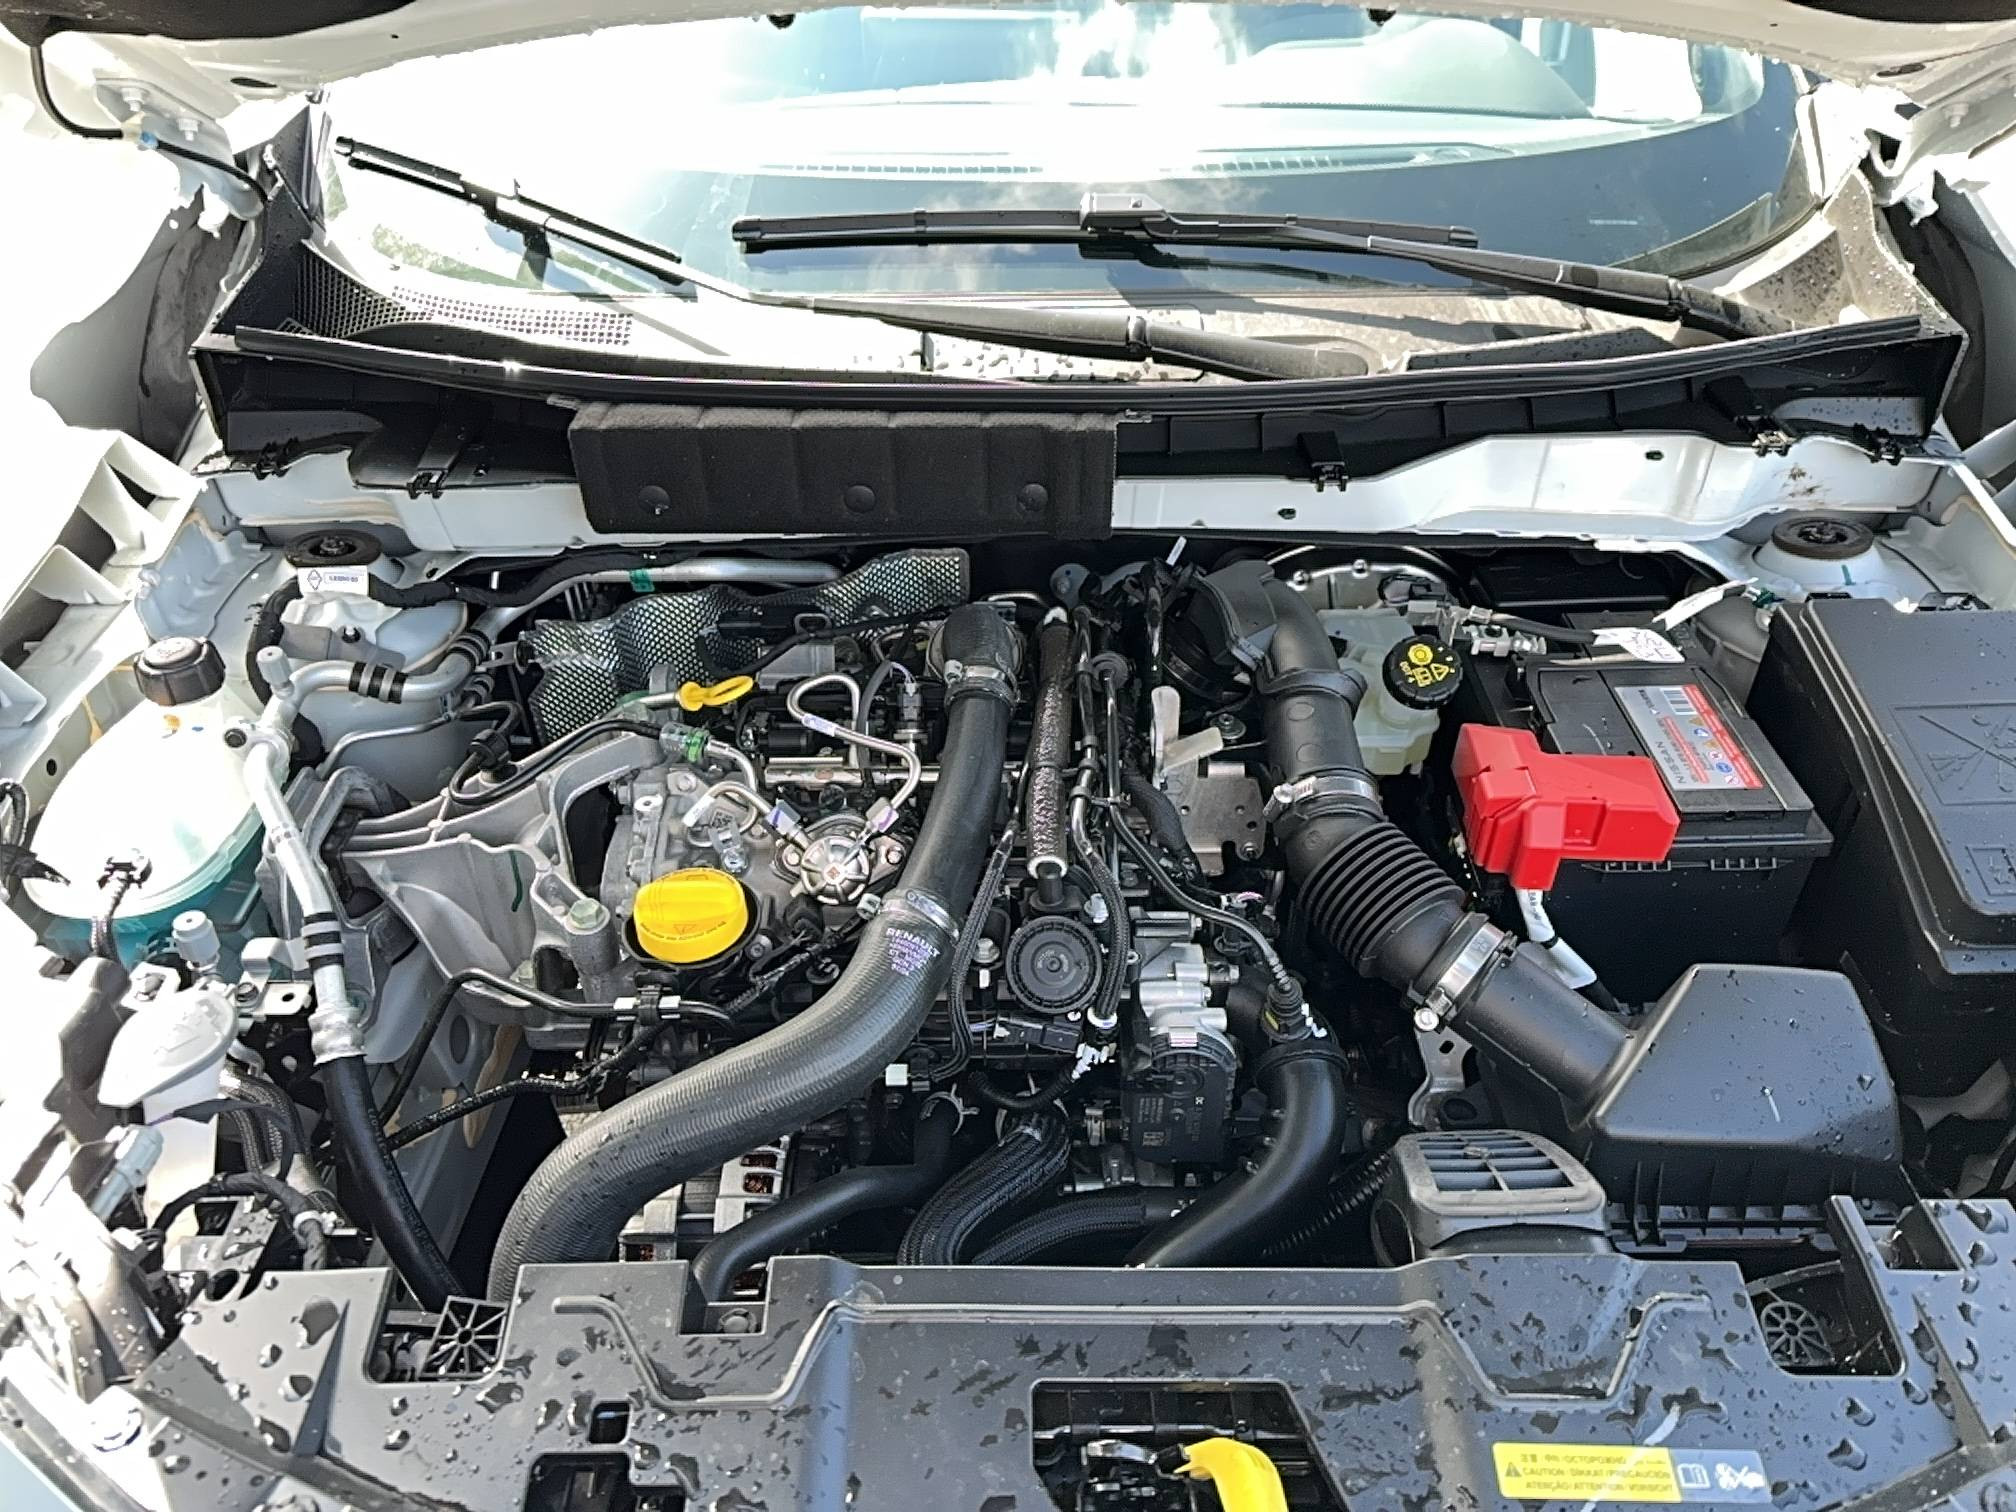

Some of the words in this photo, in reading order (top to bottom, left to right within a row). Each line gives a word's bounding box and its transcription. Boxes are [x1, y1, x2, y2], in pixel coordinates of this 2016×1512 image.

[1655, 741, 1687, 784] NISSAN
[885, 927, 941, 957] RENAULT
[1522, 1467, 1564, 1476] CAUTION
